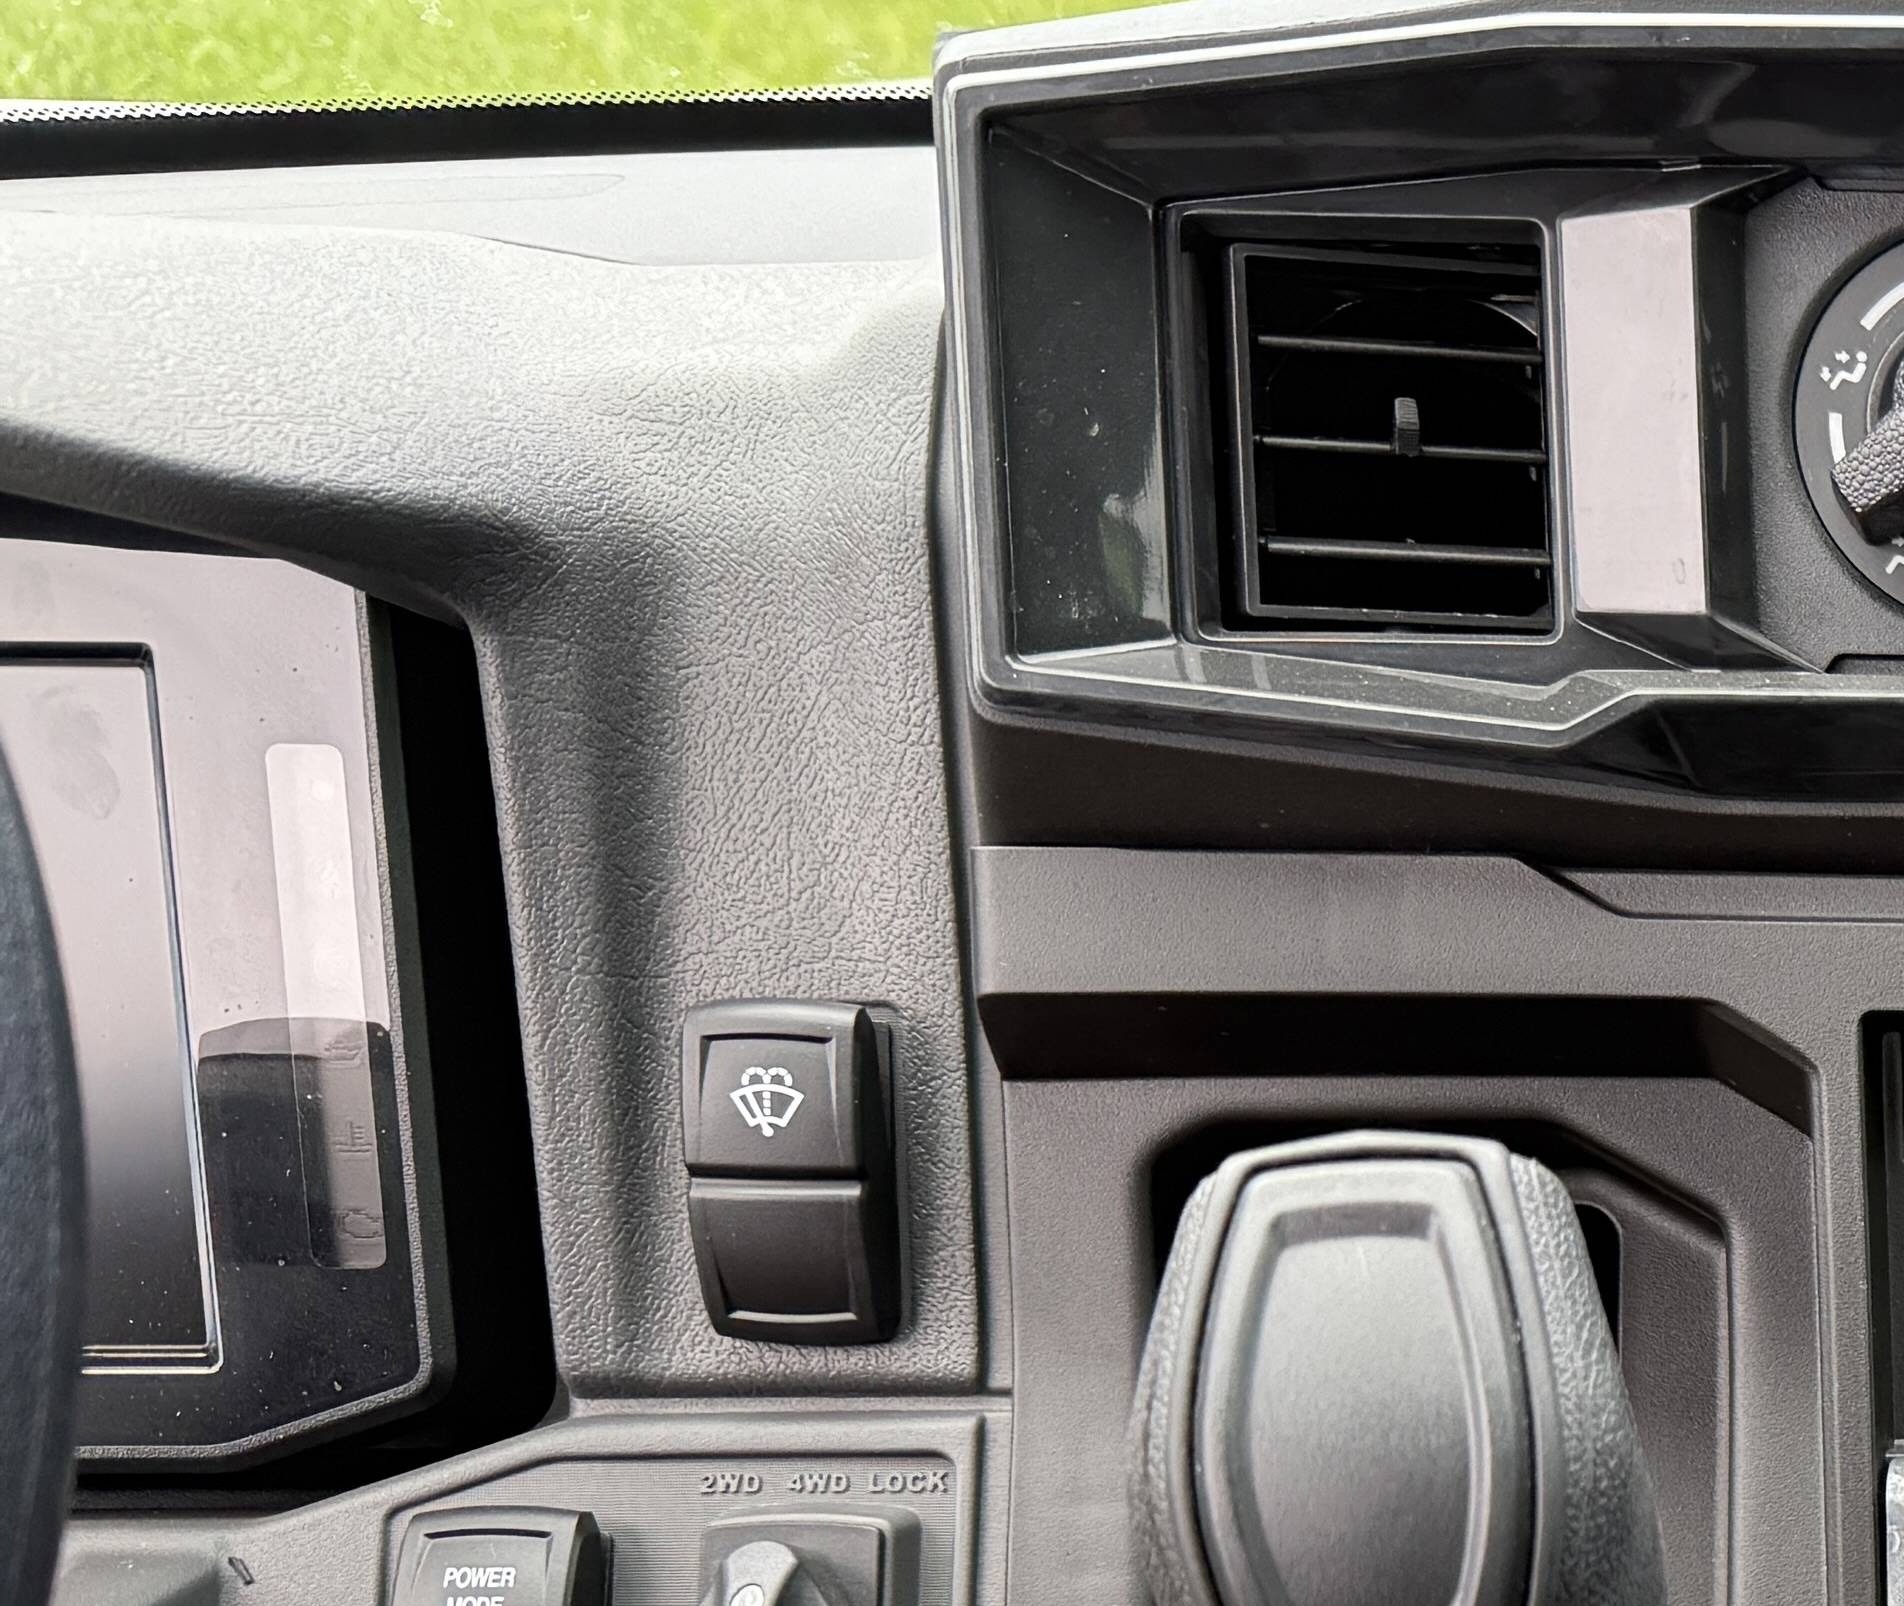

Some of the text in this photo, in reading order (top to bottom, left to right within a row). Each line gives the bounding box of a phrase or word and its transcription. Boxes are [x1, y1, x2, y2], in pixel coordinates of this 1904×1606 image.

[699, 1470, 949, 1494] 2WD 4WD LOCK
[443, 1567, 516, 1588] POWER
